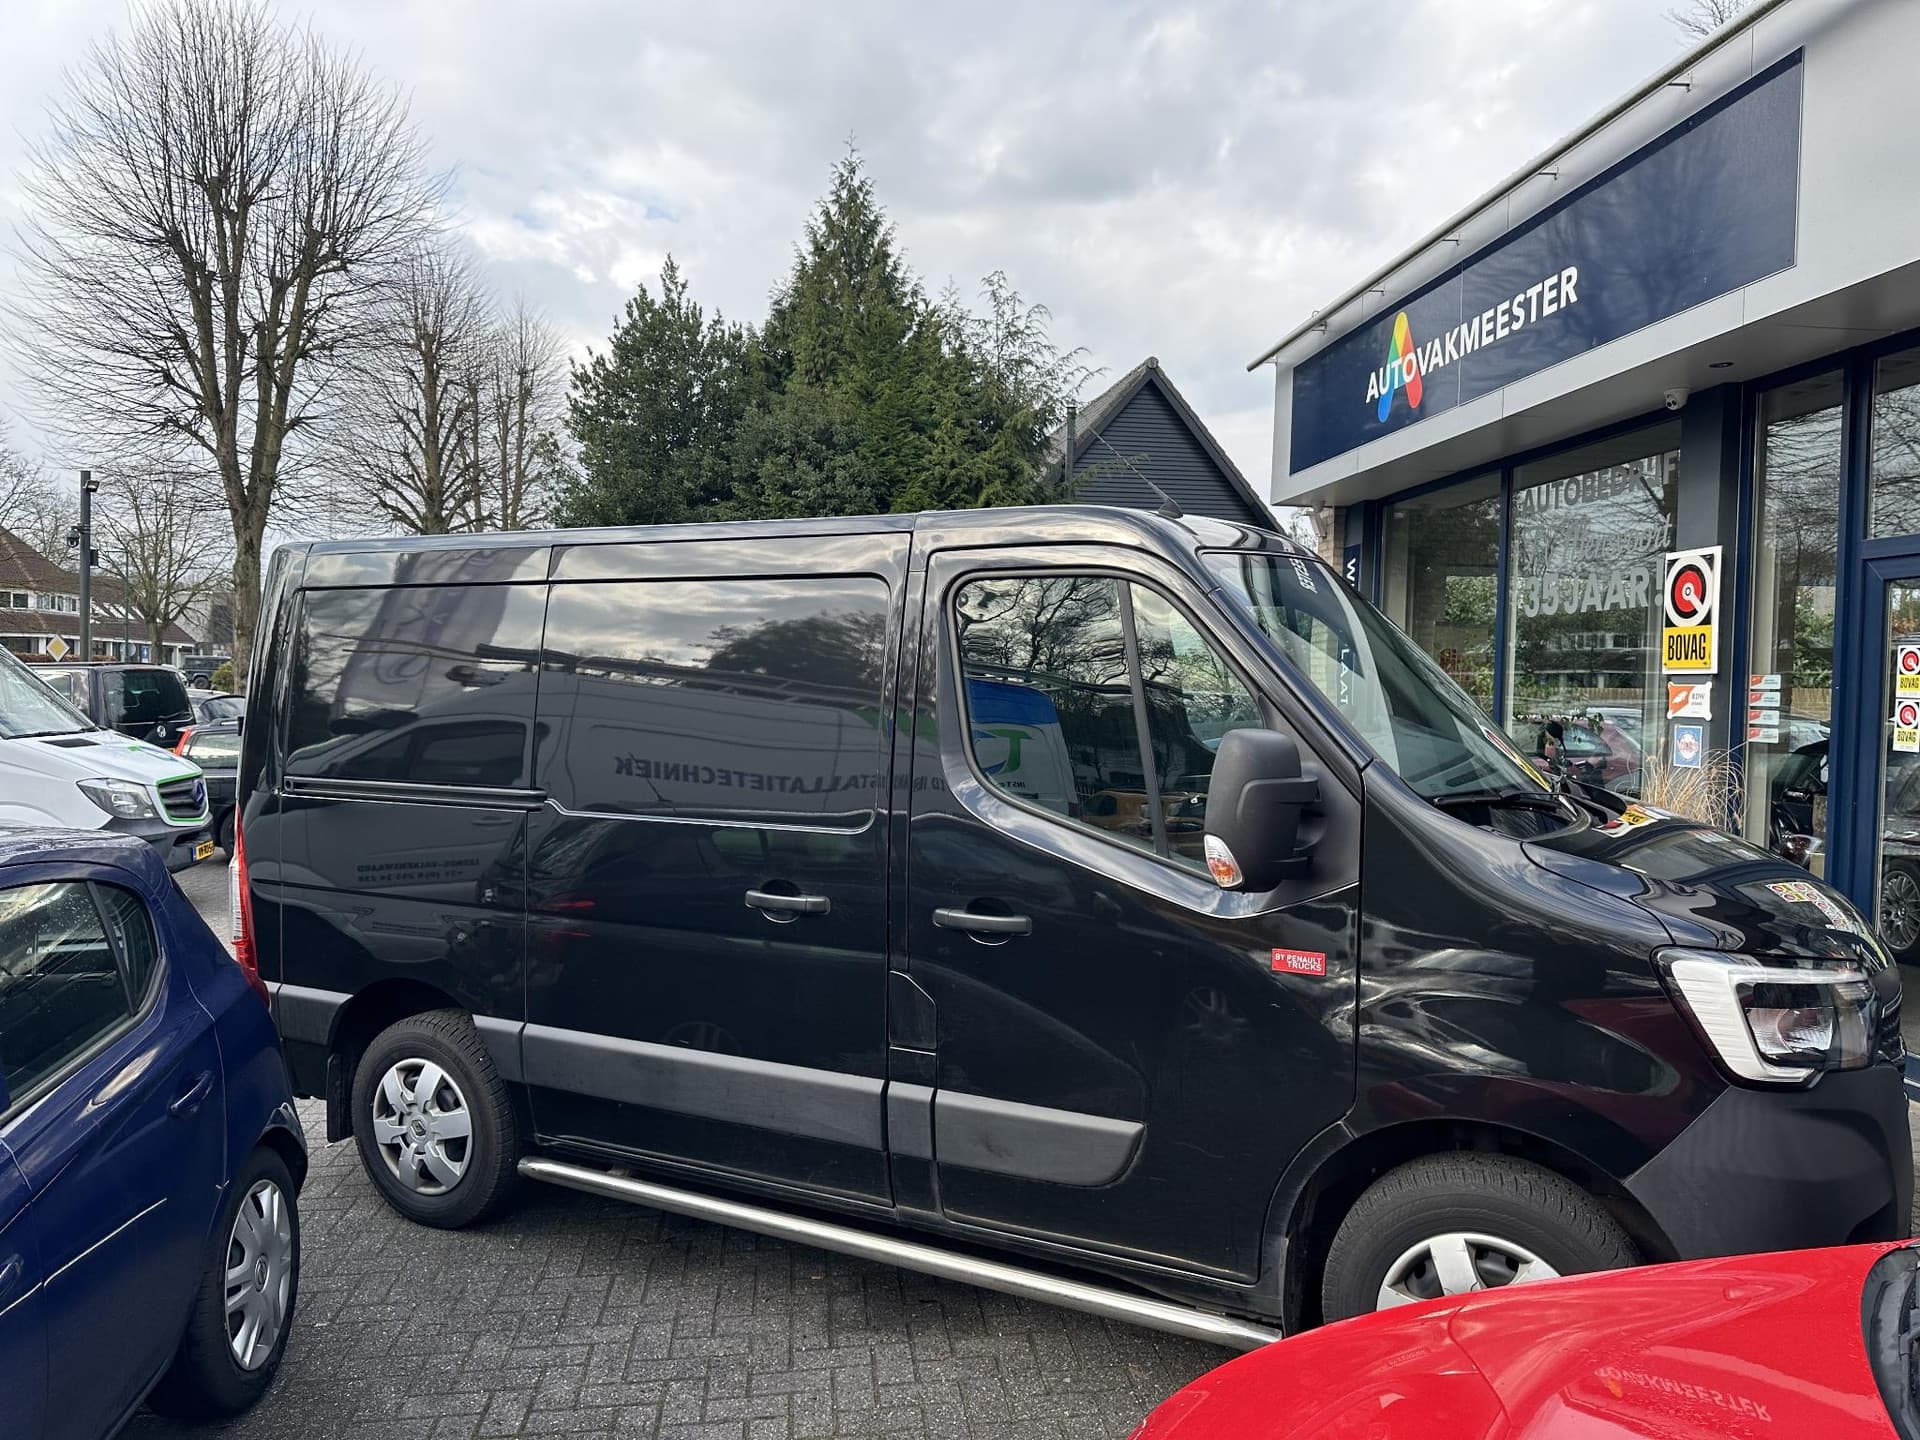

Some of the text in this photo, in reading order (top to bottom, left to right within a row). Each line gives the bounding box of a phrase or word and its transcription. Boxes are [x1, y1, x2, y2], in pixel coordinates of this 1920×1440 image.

[1365, 266, 1579, 404] AUTOVAKMEESTER
[1523, 556, 1668, 618] 35 JAAR!
[1667, 632, 1707, 661] BOVAG
[1275, 952, 1286, 961] BY
[1287, 961, 1322, 972] TRUCKS
